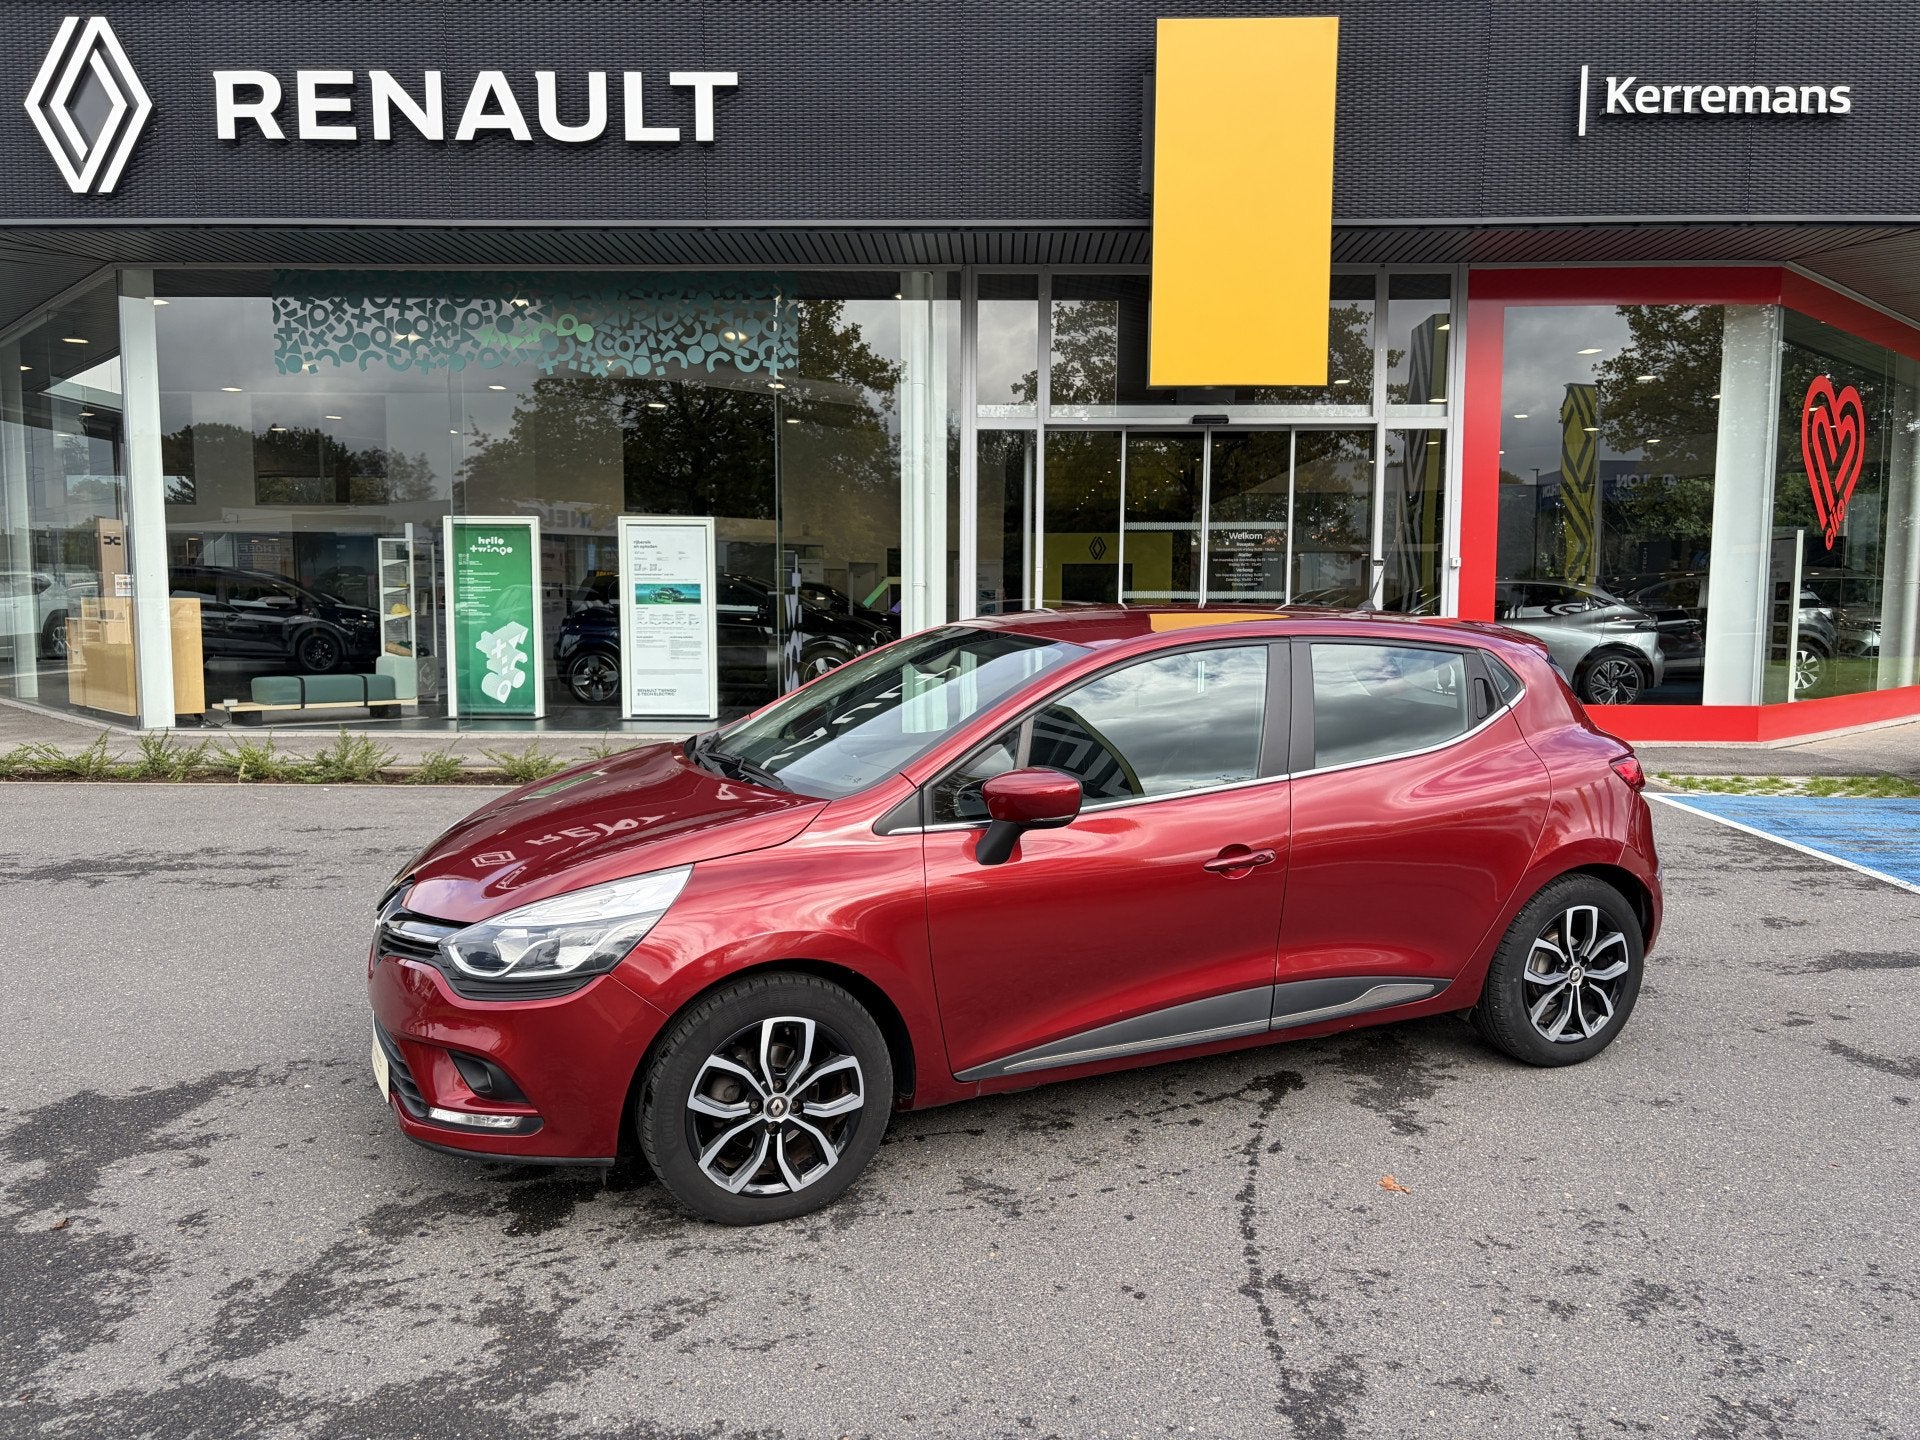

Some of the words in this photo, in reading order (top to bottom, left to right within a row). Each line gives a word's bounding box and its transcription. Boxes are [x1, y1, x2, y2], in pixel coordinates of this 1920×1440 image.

[213, 70, 738, 142] RENAULT
[1606, 76, 1851, 114] Kerremans
[477, 536, 504, 545] hello
[1229, 531, 1262, 539] Welkom
